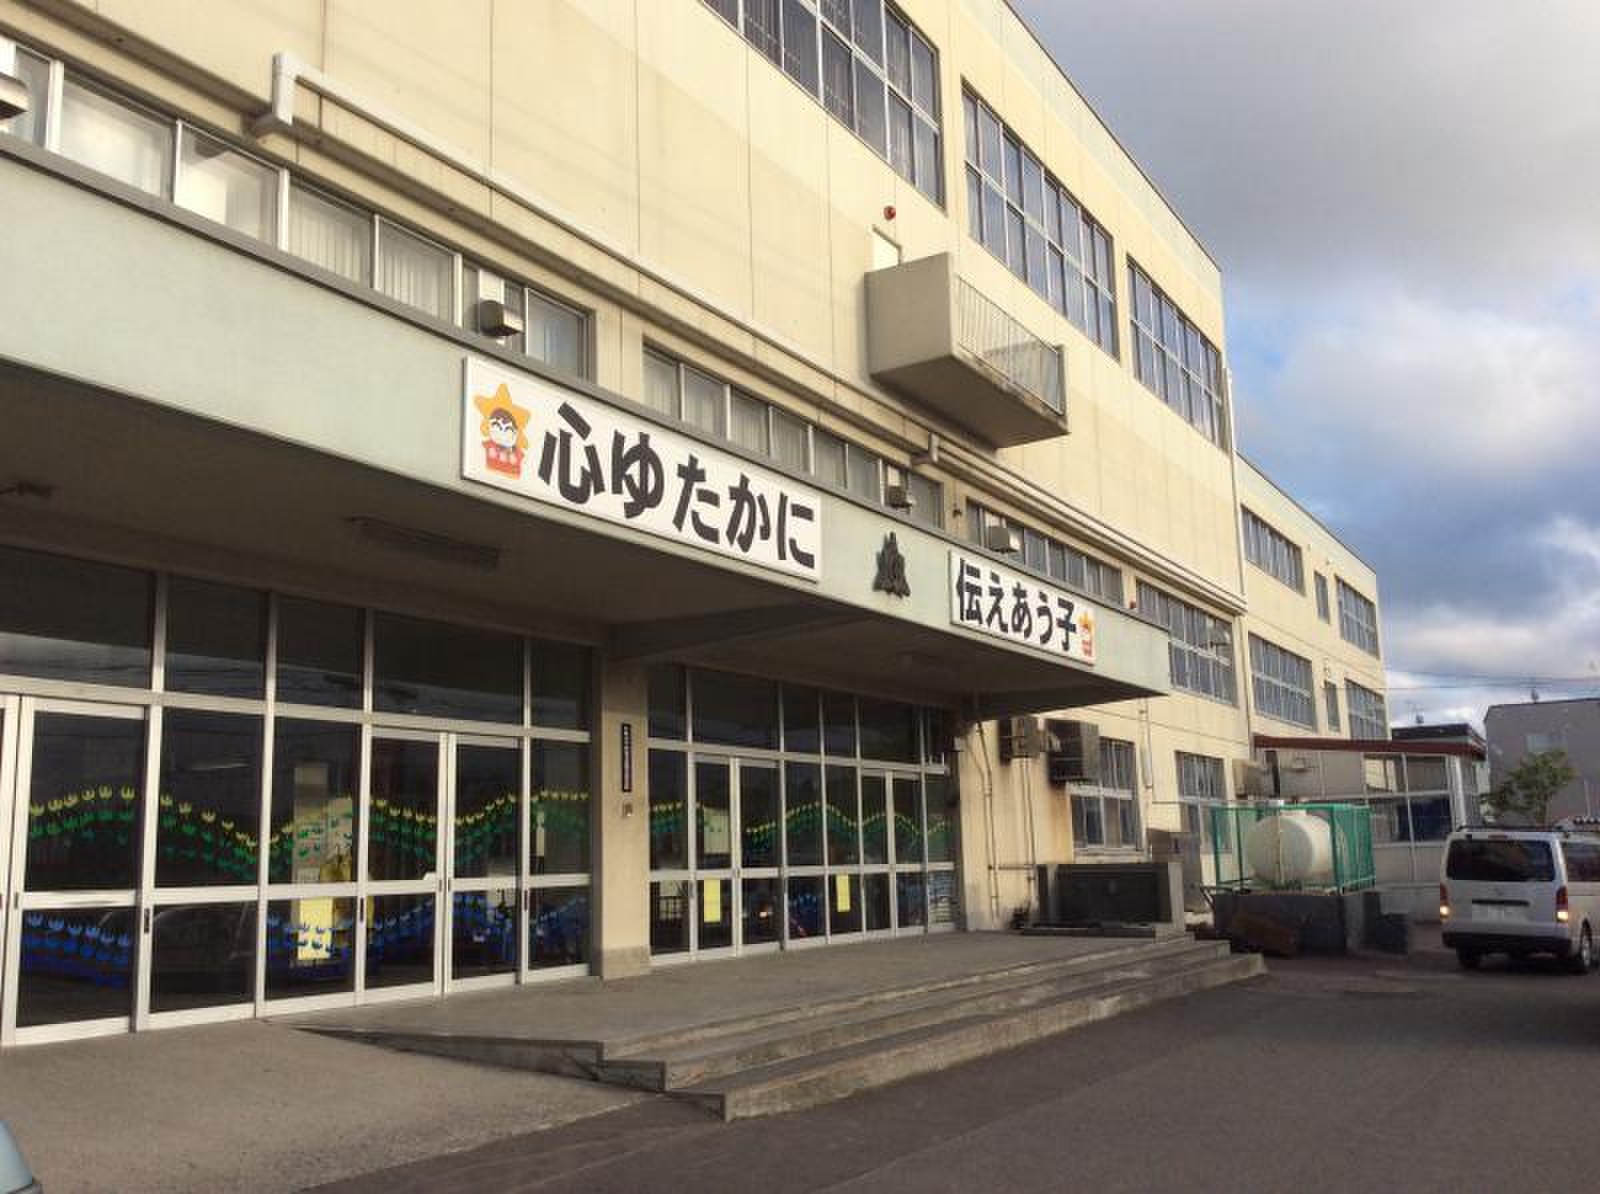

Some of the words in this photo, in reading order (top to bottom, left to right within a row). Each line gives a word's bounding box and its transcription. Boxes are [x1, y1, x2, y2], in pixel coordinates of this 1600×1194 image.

[538, 401, 815, 569] 心ゆたかに
[956, 558, 1077, 651] 伝えあう子
